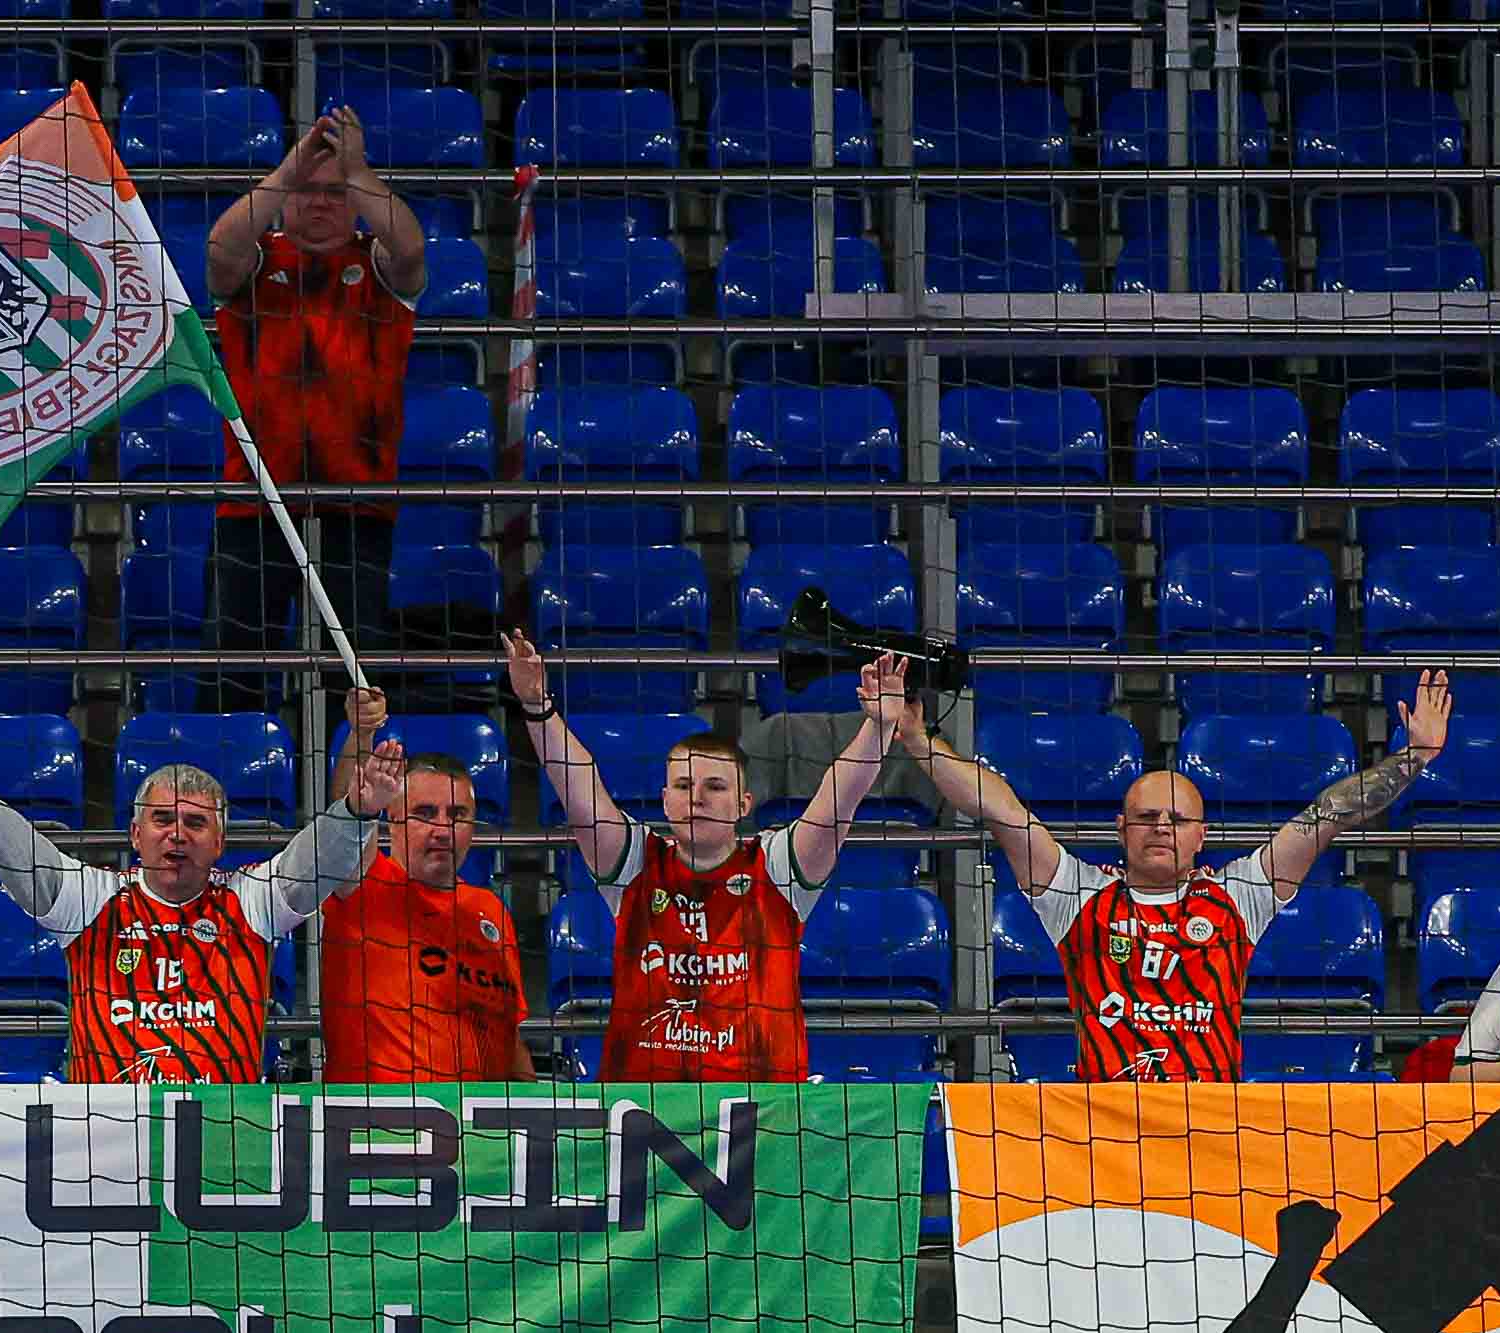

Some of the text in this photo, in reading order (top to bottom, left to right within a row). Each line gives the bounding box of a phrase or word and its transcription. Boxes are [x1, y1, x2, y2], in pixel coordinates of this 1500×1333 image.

[155, 957, 184, 991] 15
[669, 952, 749, 975] KGHM
[139, 1000, 216, 1021] KGHM
[1134, 1001, 1213, 1022] KGHM
[665, 1022, 734, 1051] lubin.pl
[26, 1096, 760, 1234] LUBIN
